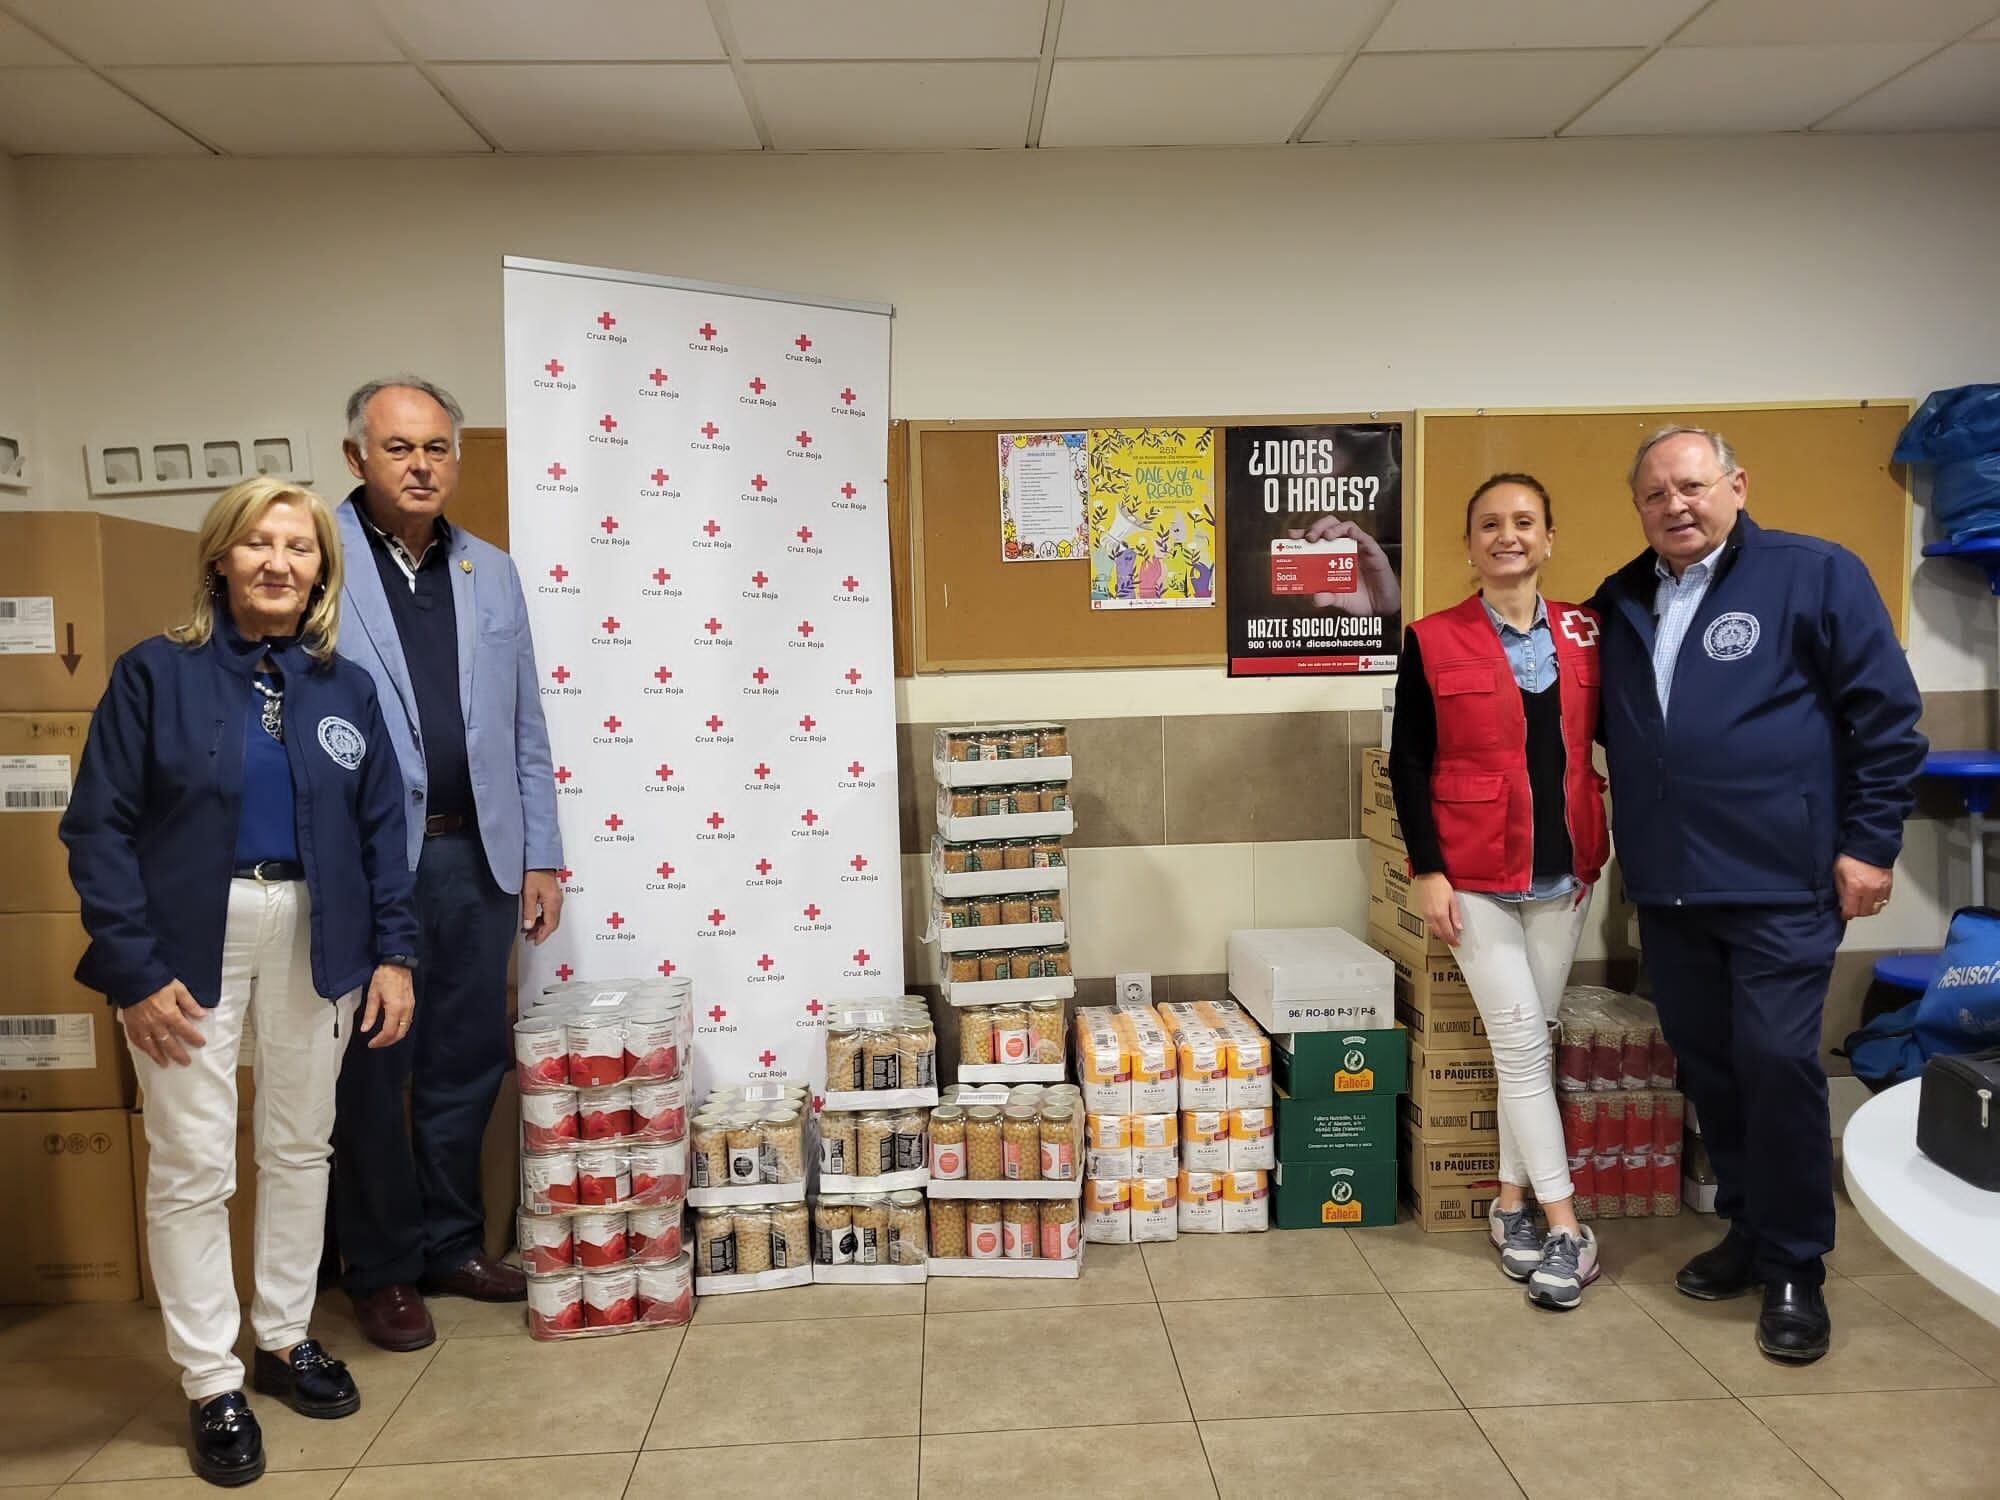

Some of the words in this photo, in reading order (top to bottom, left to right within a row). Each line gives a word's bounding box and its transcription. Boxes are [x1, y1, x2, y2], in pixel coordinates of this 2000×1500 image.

[587, 332, 606, 341] Cruz
[609, 334, 627, 344] Roja
[689, 342, 708, 352] Cruz
[710, 344, 728, 353] Roja
[786, 353, 803, 363] Cruz
[805, 355, 821, 364] Roja
[534, 379, 554, 389] Cruz
[557, 381, 576, 390] Roja
[639, 388, 658, 397] Cruz
[660, 390, 679, 399] Roja
[740, 395, 757, 405] Cruz
[760, 398, 776, 407] Roja
[832, 406, 848, 415] Cruz
[850, 408, 865, 417] Roja
[589, 434, 608, 444] Cruz
[610, 436, 628, 446] Roja
[691, 442, 710, 450] Cruz
[712, 442, 730, 452] Roja
[787, 449, 804, 458] Cruz
[805, 451, 822, 460] Roja
[1249, 439, 1333, 476] ¿DICES
[536, 483, 556, 492] Cruz
[560, 483, 578, 493] Roja
[1147, 482, 1193, 499] RESPETO
[640, 489, 660, 497] Cruz
[662, 488, 680, 499] Roja
[741, 493, 759, 502] Cruz
[761, 495, 777, 504] Roja
[1264, 478, 1279, 513] O
[1288, 476, 1380, 513] HACES?
[832, 501, 848, 510] Cruz
[851, 502, 866, 511] Roja
[591, 536, 609, 545] Cruz
[612, 537, 630, 547] Roja
[692, 540, 711, 548] Cruz
[714, 540, 731, 549] Roja
[787, 545, 804, 553] Cruz
[807, 546, 822, 555] Roja
[1328, 557, 1354, 570] +16
[1276, 572, 1297, 581] Socia
[539, 585, 559, 594] Cruz
[562, 585, 581, 595] Roja
[642, 588, 662, 597] Cruz
[664, 588, 682, 597] Roja
[742, 590, 760, 599] Cruz
[762, 591, 778, 600] Roja
[833, 594, 851, 603] Cruz
[853, 594, 869, 603] Roja
[1248, 619, 1288, 638] HAZTE
[1293, 616, 1382, 638] SOCIO/SOCIA
[592, 637, 610, 646] Cruz
[613, 636, 631, 646] Roja
[694, 638, 712, 646] Cruz
[716, 637, 732, 647] Roja
[788, 640, 805, 648] Cruz
[808, 640, 824, 648] Roja
[1248, 641, 1265, 649] 900
[1267, 640, 1283, 648] 100
[1285, 640, 1302, 648] 014
[1306, 639, 1382, 649] dicesohaces.org
[540, 686, 560, 695] Cruz
[563, 687, 581, 696] Roja
[644, 687, 663, 695] Cruz
[666, 687, 683, 695] Roja
[744, 687, 760, 695] Cruz
[763, 687, 779, 696] Roja
[835, 687, 853, 695] Cruz
[856, 687, 872, 696] Roja
[593, 736, 612, 745] Cruz
[615, 735, 633, 744] Roja
[695, 735, 714, 744] Cruz
[717, 735, 734, 744] Roja
[790, 735, 808, 743] Cruz
[810, 735, 826, 743] Roja
[645, 784, 664, 793] Cruz
[667, 784, 685, 792] Roja
[745, 783, 762, 791] Cruz
[764, 781, 780, 791] Roja
[838, 781, 856, 789] Cruz
[858, 779, 875, 789] Roja
[565, 786, 582, 794] Roja
[594, 835, 614, 843] Cruz
[616, 833, 634, 843] Roja
[696, 833, 715, 841] Cruz
[718, 831, 735, 840] Roja
[792, 829, 809, 838] Cruz
[812, 828, 829, 837] Roja
[746, 879, 763, 887] Cruz
[766, 877, 782, 886] Roja
[841, 875, 859, 883] Cruz
[861, 873, 878, 882] Roja
[565, 885, 584, 894] Roja
[646, 882, 665, 891] Cruz
[668, 881, 686, 890] Roja
[794, 924, 812, 932] Cruz
[814, 922, 831, 932] Roja
[596, 933, 616, 941] Cruz
[617, 931, 635, 941] Roja
[697, 929, 717, 937] Cruz
[719, 928, 736, 936] Roja
[864, 968, 880, 976] Roja
[747, 975, 765, 983] Cruz
[768, 972, 784, 982] Roja
[1306, 1008, 1335, 1017] RO-80
[1338, 1008, 1352, 1016] P-3
[1361, 1007, 1376, 1015] P-6
[698, 1025, 717, 1034] Cruz
[720, 1023, 737, 1032] Roja
[796, 1020, 814, 1028] Cruz
[1433, 1022, 1471, 1033] MACARRONES
[749, 1071, 768, 1081] Cruz
[769, 1069, 787, 1079] Roja
[1430, 1070, 1441, 1080] 18
[1445, 1069, 1494, 1080] PAQUETES
[1338, 1075, 1370, 1089] Fallera
[1430, 1115, 1468, 1127] MACARRONES
[1430, 1161, 1441, 1171] 18
[1444, 1160, 1495, 1171] PAQUETES
[1440, 1200, 1460, 1210] FIDEO
[1325, 1207, 1359, 1220] Fallera
